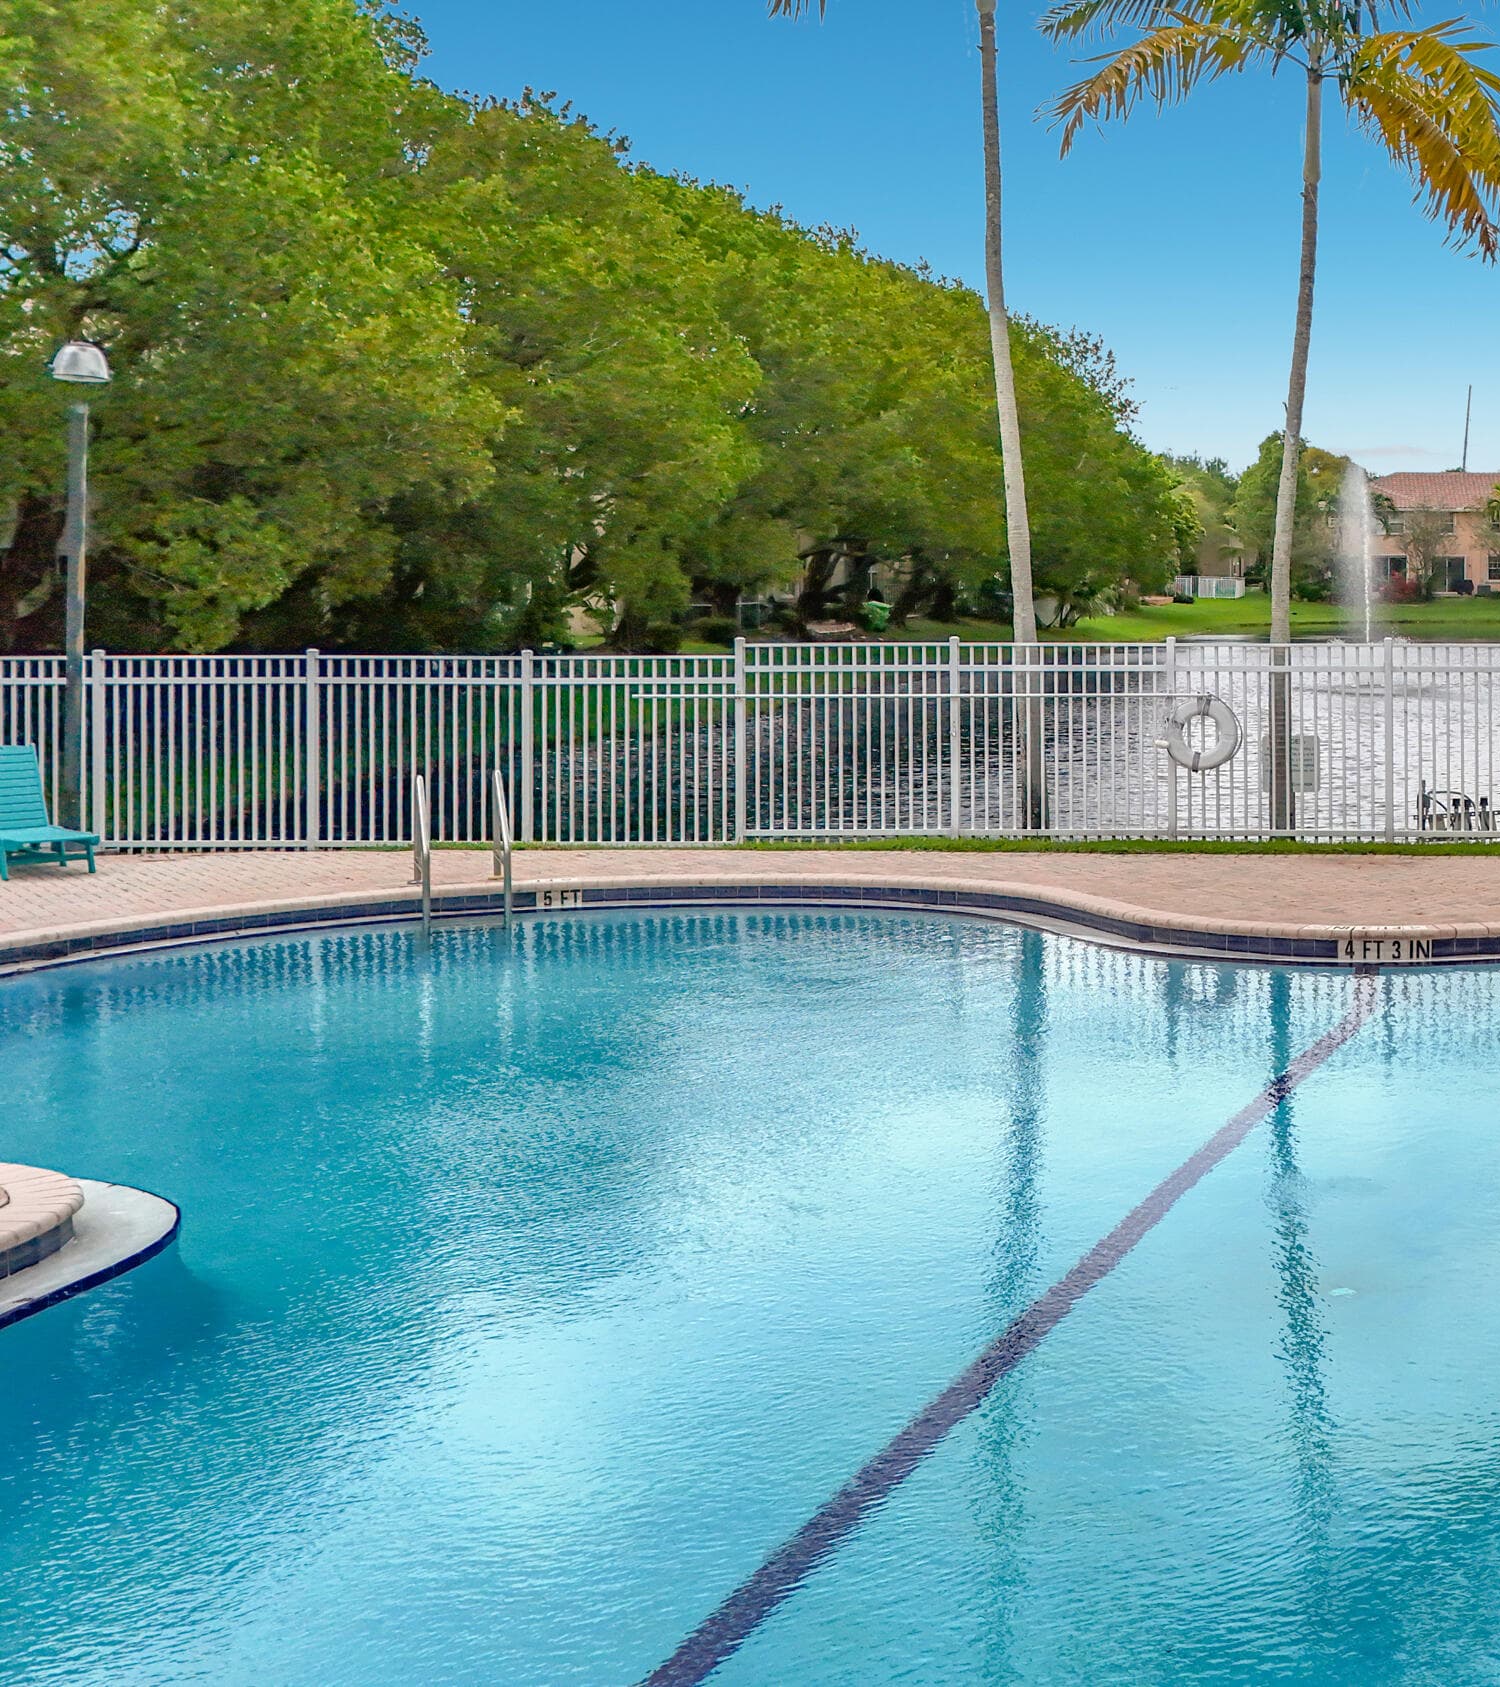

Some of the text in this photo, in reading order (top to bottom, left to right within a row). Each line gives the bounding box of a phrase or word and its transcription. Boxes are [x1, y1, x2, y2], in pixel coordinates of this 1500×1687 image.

[544, 889, 581, 906] 5 FT
[1345, 940, 1430, 959] 4 FT 3 IN
